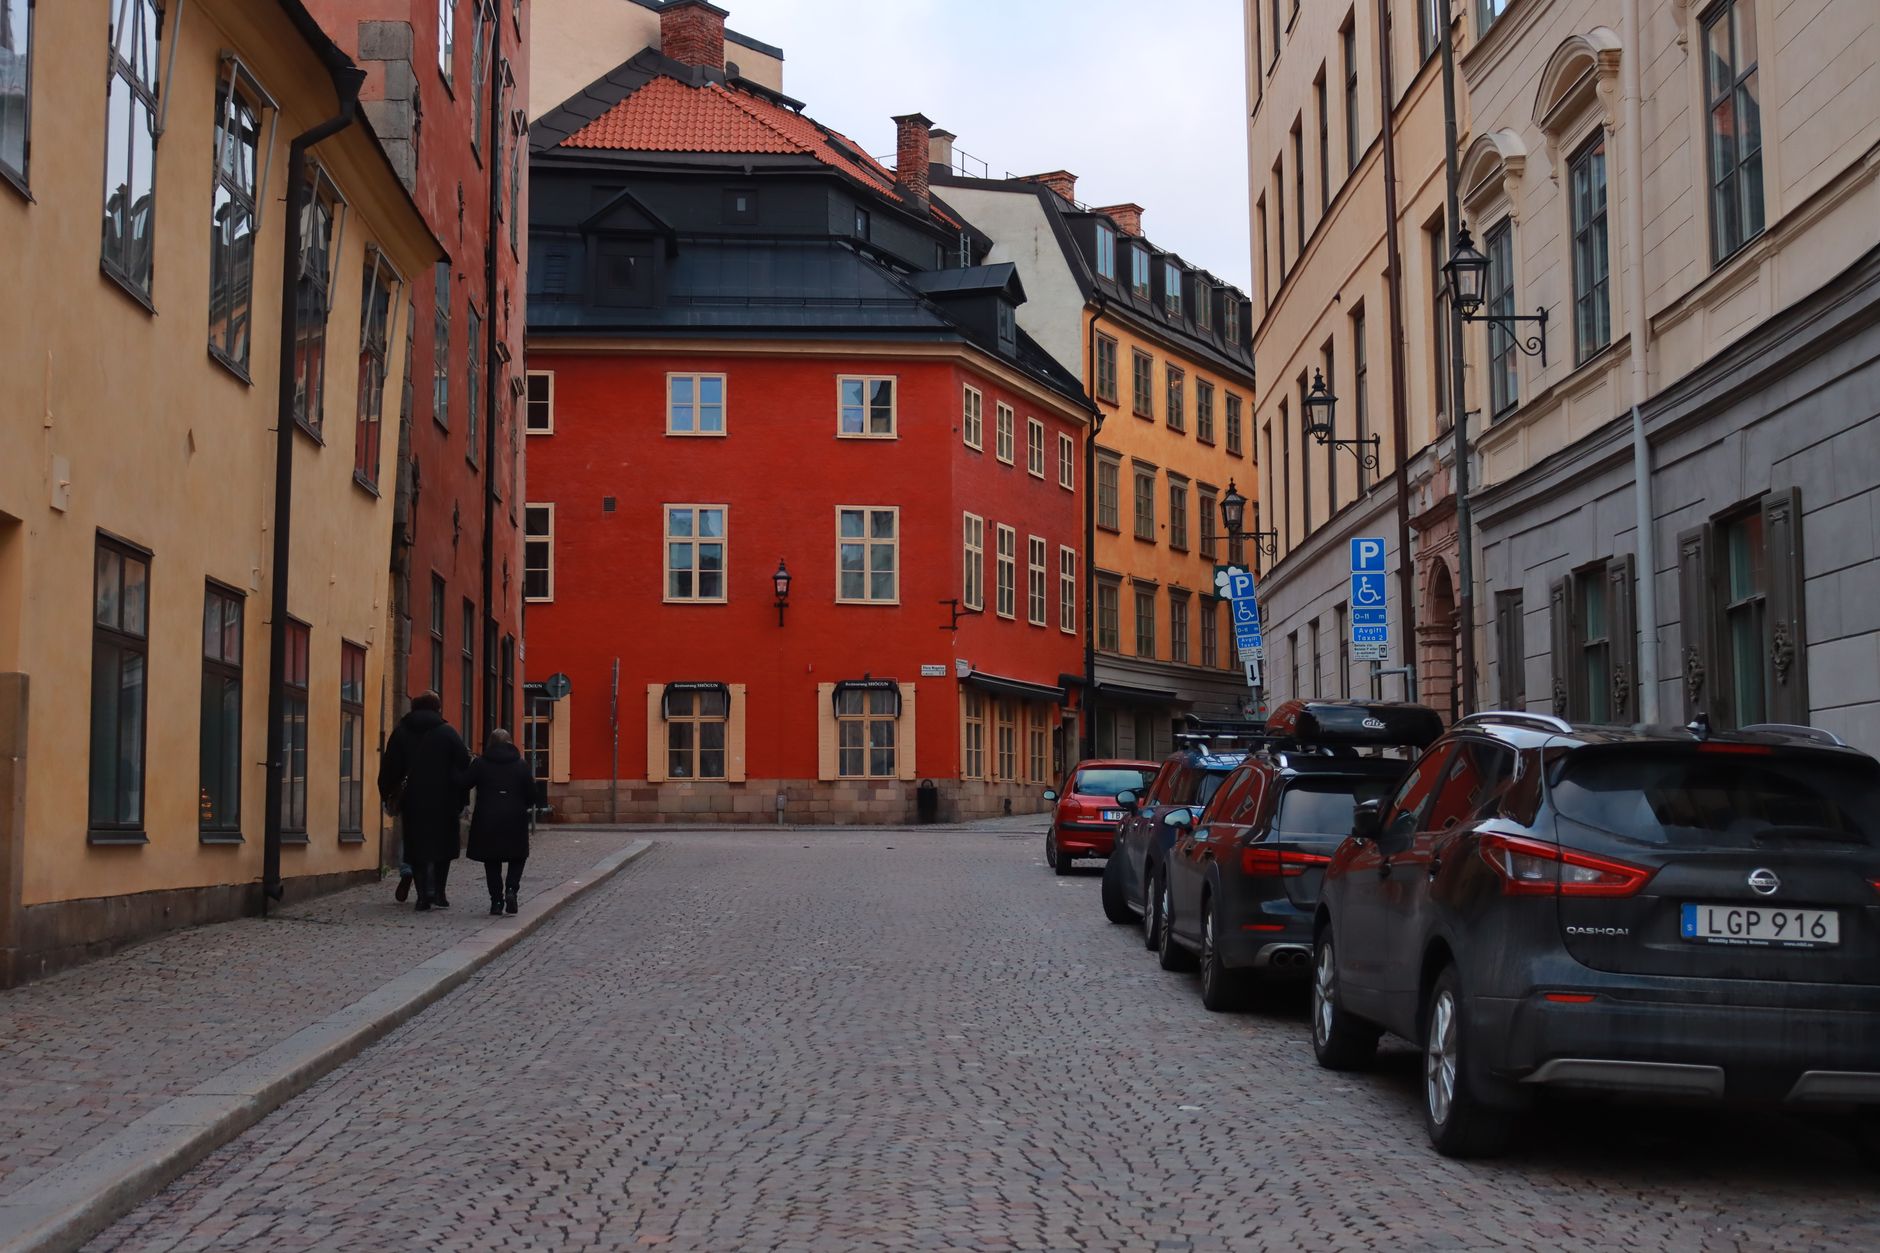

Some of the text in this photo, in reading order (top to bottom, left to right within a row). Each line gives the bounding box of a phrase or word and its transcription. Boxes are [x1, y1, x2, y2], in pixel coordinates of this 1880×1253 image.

[1359, 541, 1380, 569] P
[1235, 576, 1250, 596] P
[1362, 717, 1387, 729] Calix
[1566, 926, 1629, 936] QASHQAI
[1708, 909, 1827, 939] LGP 916
